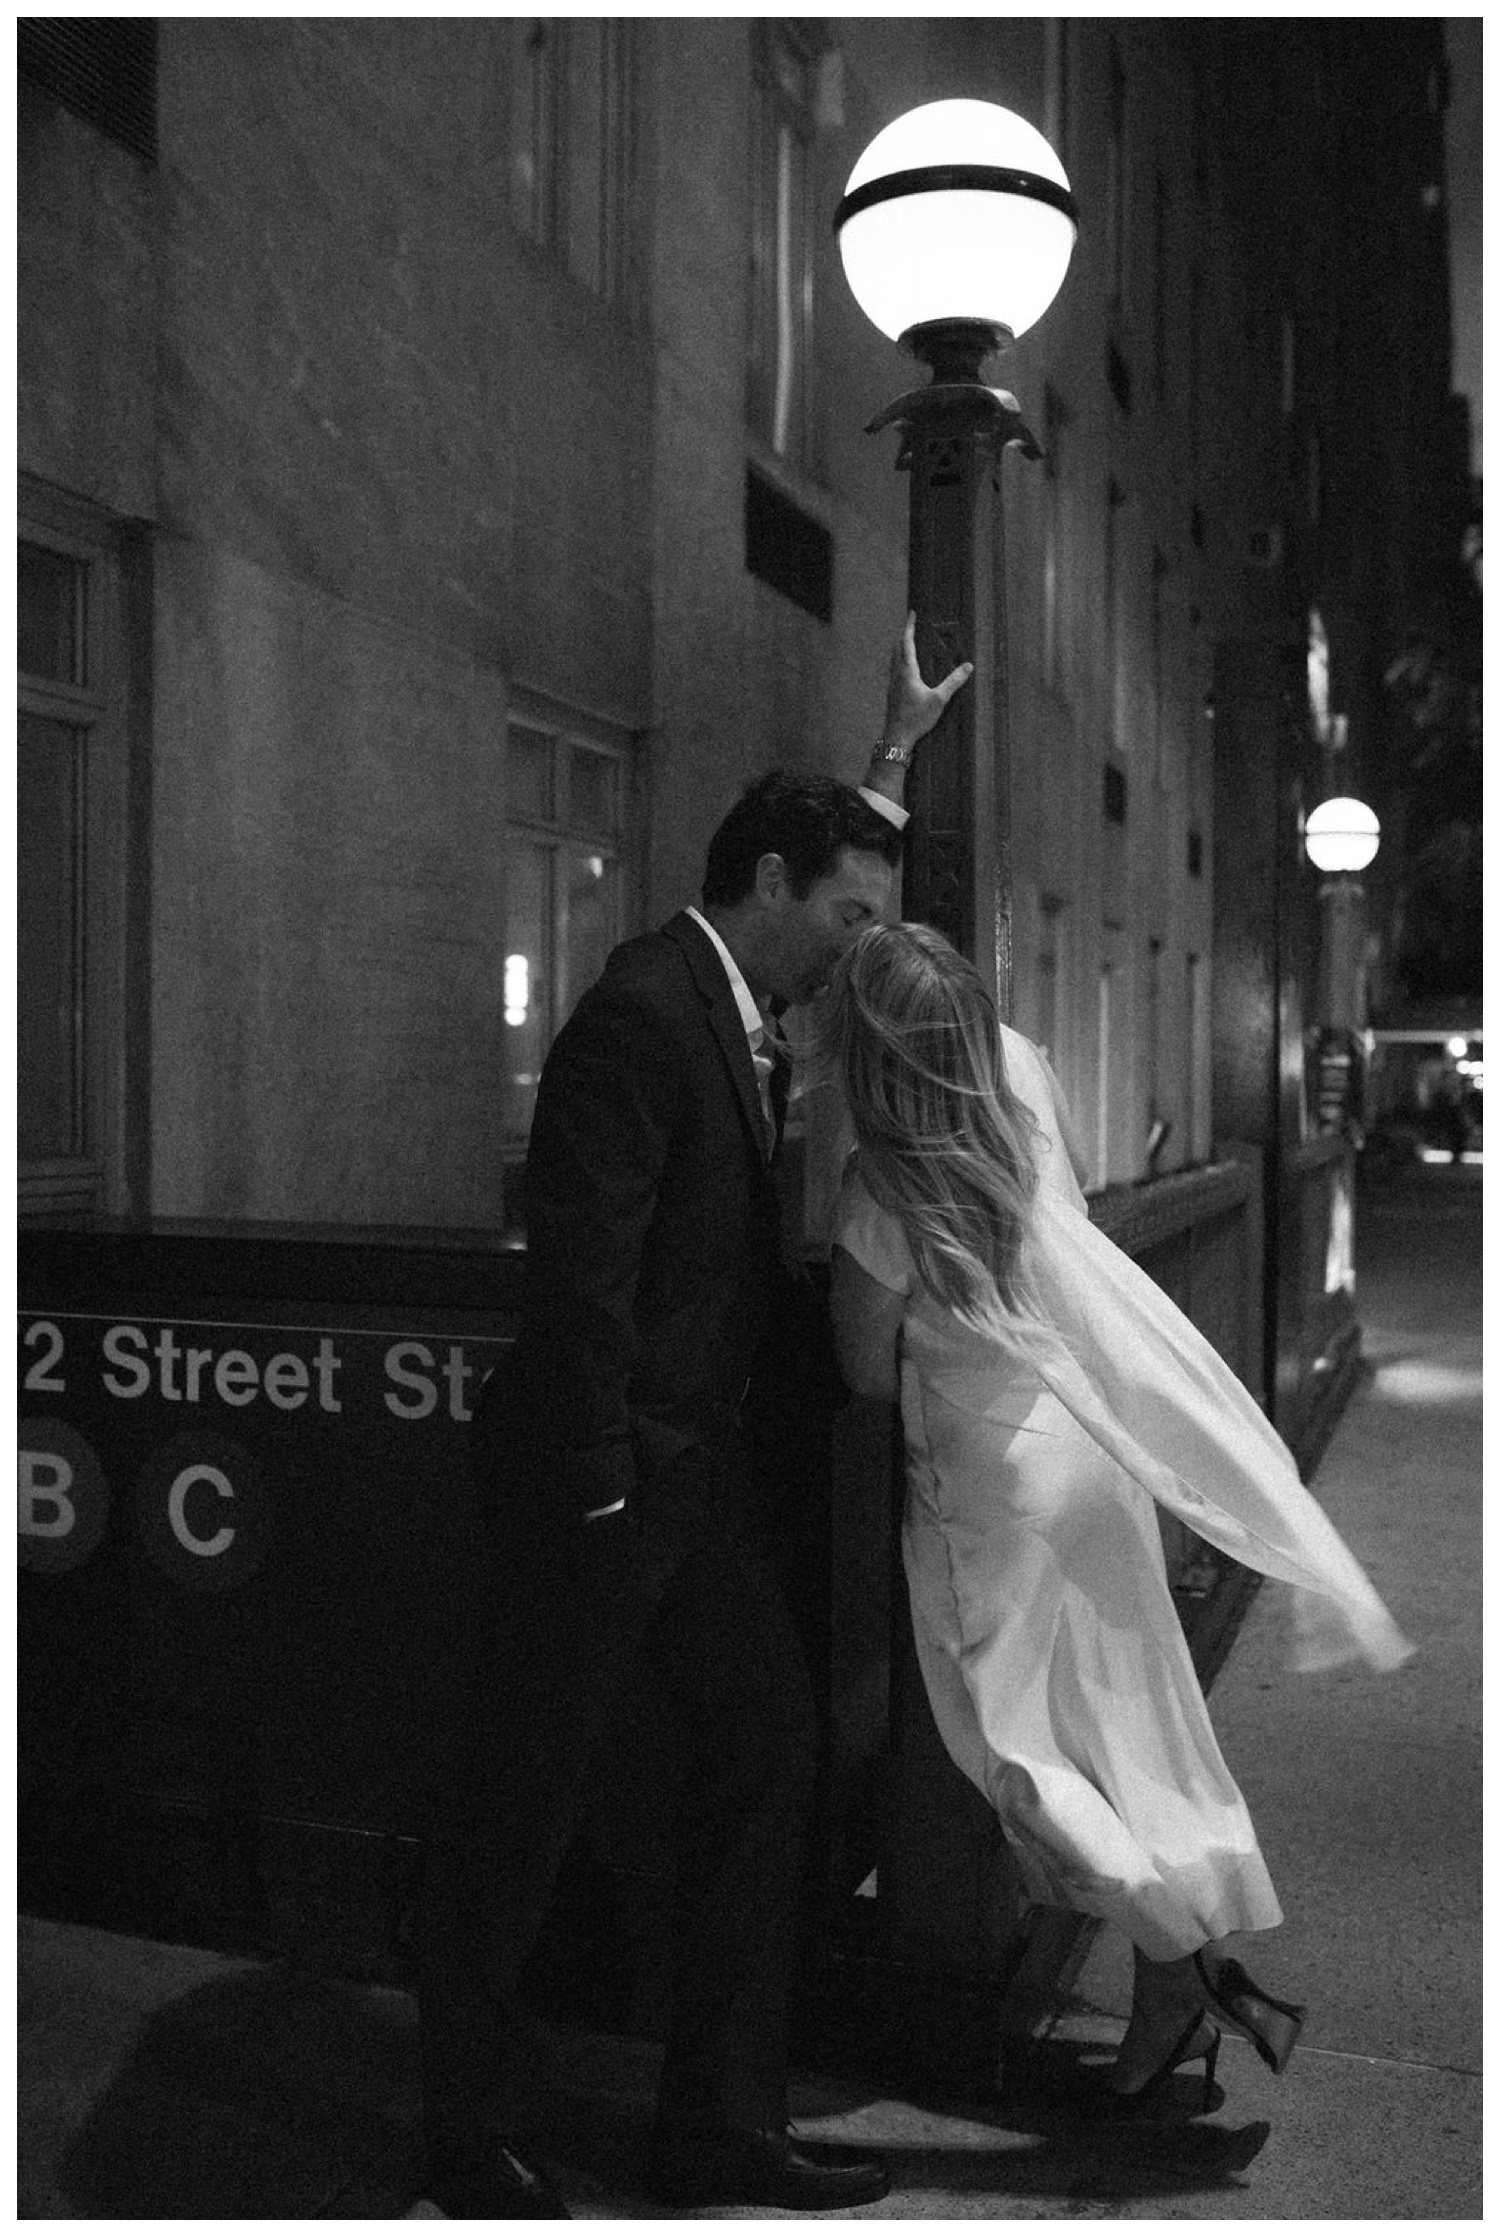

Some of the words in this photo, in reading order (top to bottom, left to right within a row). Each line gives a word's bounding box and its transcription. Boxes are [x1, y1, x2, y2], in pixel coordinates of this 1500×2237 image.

[23, 1320, 66, 1392] 2
[102, 1325, 342, 1413] Street
[384, 1341, 495, 1422] St
[17, 1450, 76, 1538] B
[167, 1464, 236, 1557] C
